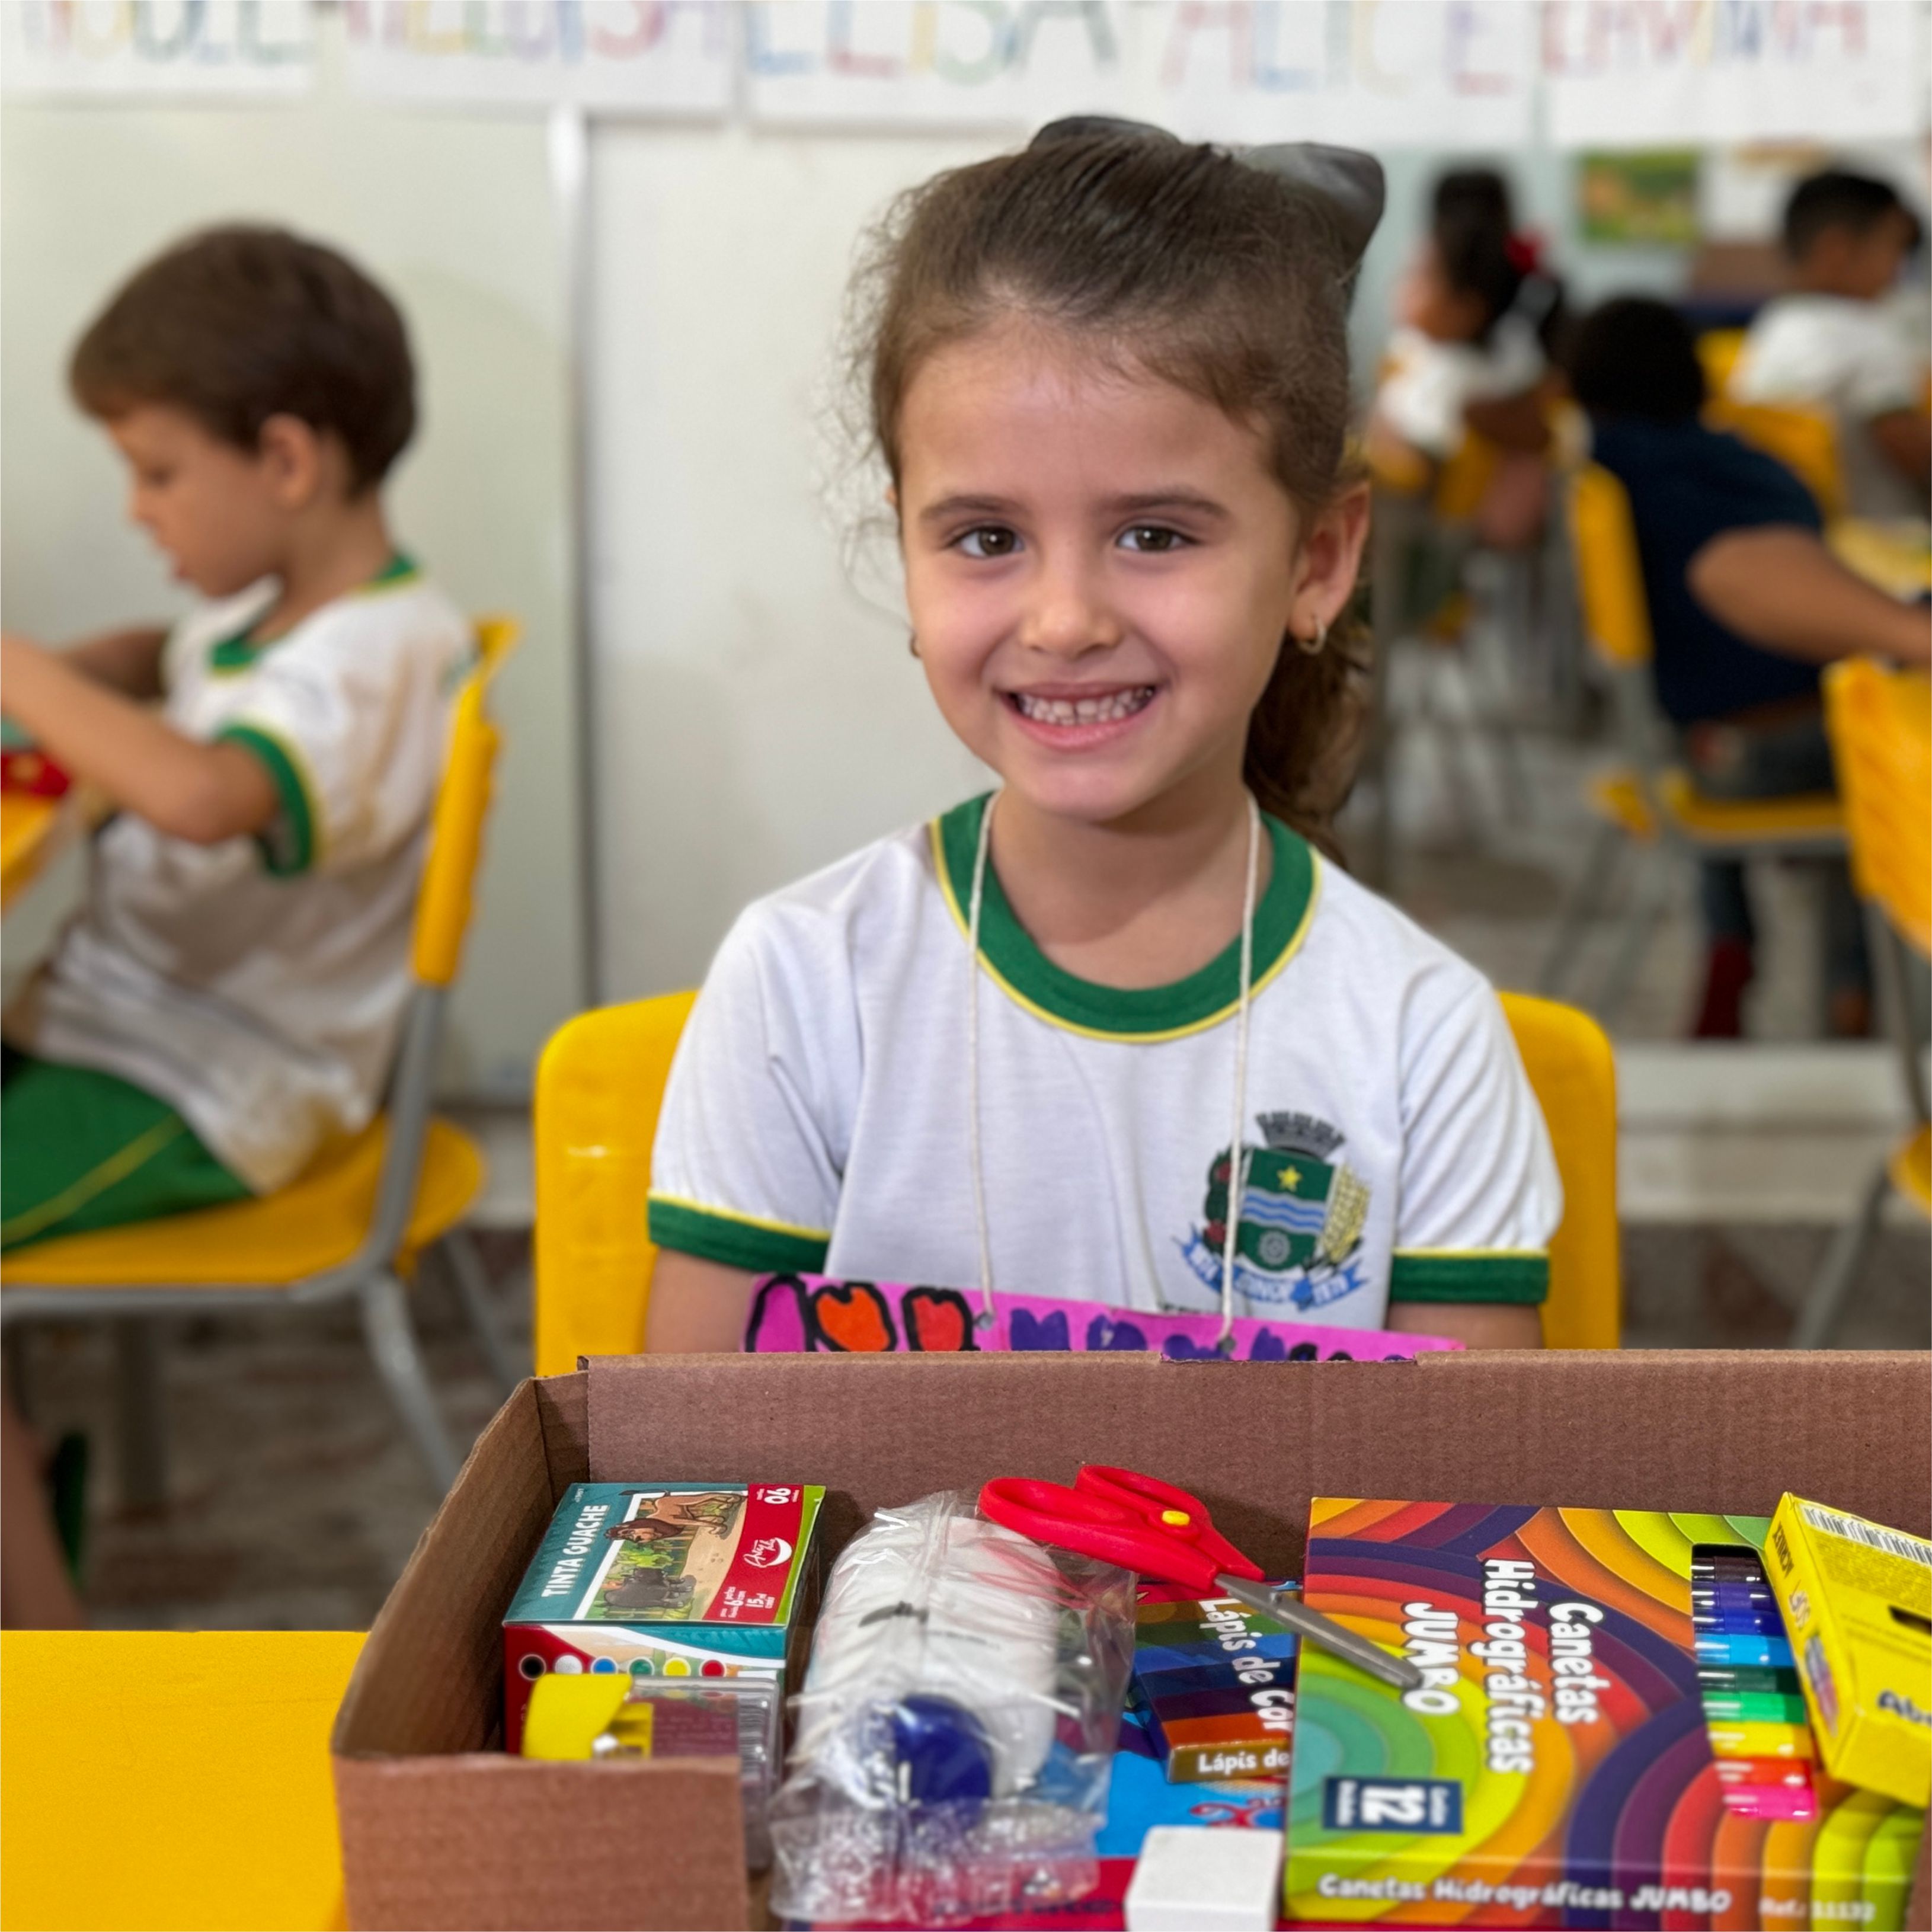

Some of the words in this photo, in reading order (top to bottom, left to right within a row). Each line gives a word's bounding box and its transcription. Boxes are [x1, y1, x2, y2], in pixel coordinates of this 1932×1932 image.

[765, 1488, 790, 1504] 06
[542, 1556, 583, 1598] TINTA
[563, 1504, 608, 1556] GUACHE
[1198, 1599, 1262, 1651] Lápis
[1231, 1656, 1281, 1684] de
[1401, 1602, 1461, 1715] JUMBO
[1470, 1559, 1544, 1774] Hidrográficas
[1549, 1601, 1610, 1725] Canetas
[1249, 1690, 1294, 1731] Cor
[1198, 1751, 1256, 1774] Lápis
[1264, 1749, 1290, 1767] de
[1361, 1786, 1425, 1824] 12
[1319, 1873, 1427, 1902] Canetas
[1432, 1877, 1624, 1911] Hidrográficas
[1629, 1885, 1731, 1914] JUMBO
